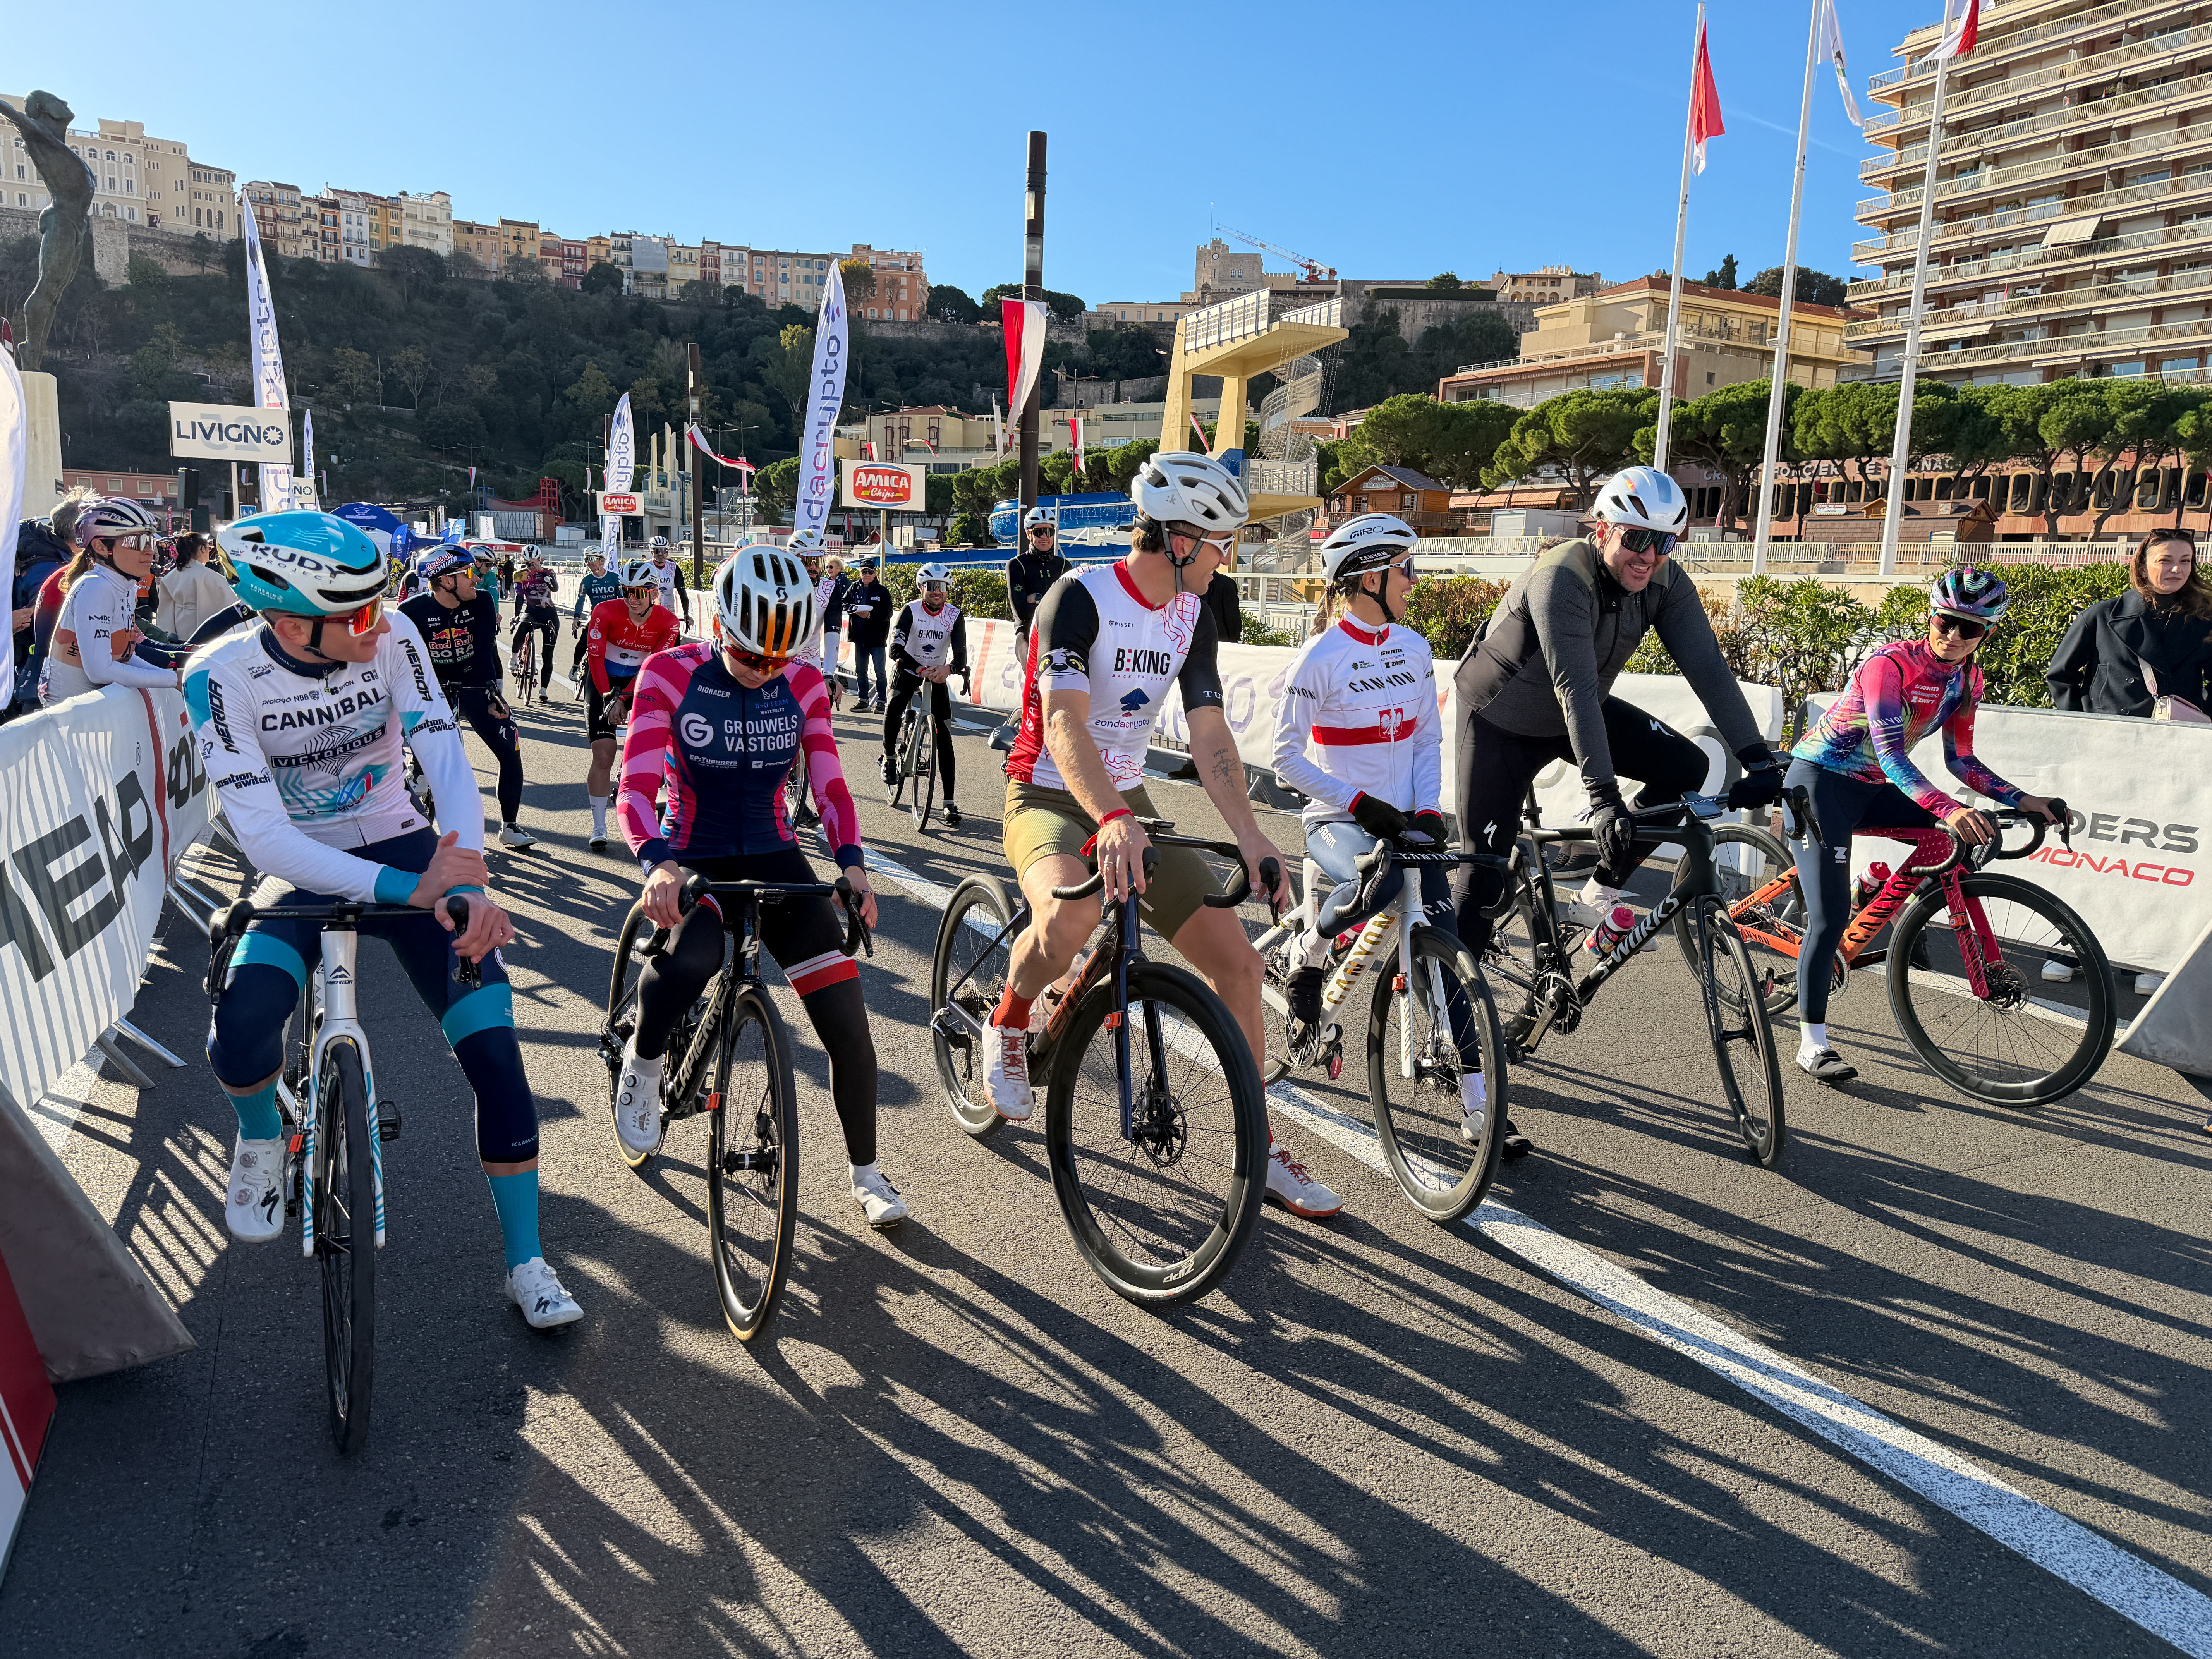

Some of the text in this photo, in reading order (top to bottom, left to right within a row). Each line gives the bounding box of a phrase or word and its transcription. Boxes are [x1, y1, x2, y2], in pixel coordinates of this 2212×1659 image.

[803, 335, 840, 529] dacrypto
[855, 472, 909, 488] AMICA
[605, 497, 635, 505] AMICA
[870, 488, 895, 500] Chips
[100, 512, 127, 521] MET
[1350, 526, 1383, 539] GIRO
[251, 544, 345, 579] RUDY
[426, 551, 454, 571] Red Bull
[1359, 551, 1388, 561] CANYON
[256, 556, 333, 584] PROJECT
[428, 556, 457, 577] SPECIALIZED
[429, 634, 474, 650] Red Bull
[430, 644, 473, 658] BORA
[397, 639, 433, 702] MERIDA
[697, 685, 730, 698] BIORACER
[1284, 685, 1316, 699] NYON
[1348, 672, 1415, 692] CANYON
[262, 687, 386, 732] CANNIBAL
[263, 694, 309, 706] prologo NBB
[208, 678, 240, 754] MERIDA
[724, 714, 797, 735] GROUWELS
[1094, 719, 1149, 729] zondacrypto
[278, 728, 383, 766] VICTORIOUS
[725, 732, 797, 752] VASTGOED
[690, 754, 737, 765] EP:Tummers
[1318, 825, 1336, 849] SRAM
[2023, 843, 2195, 887] MONACO
[1730, 896, 1755, 915] SRAM
[1848, 877, 1917, 943] CANYO
[1590, 895, 1680, 980] S-WORKS
[1327, 911, 1396, 1006] CANYON
[675, 985, 727, 1099] LAPIERRE
